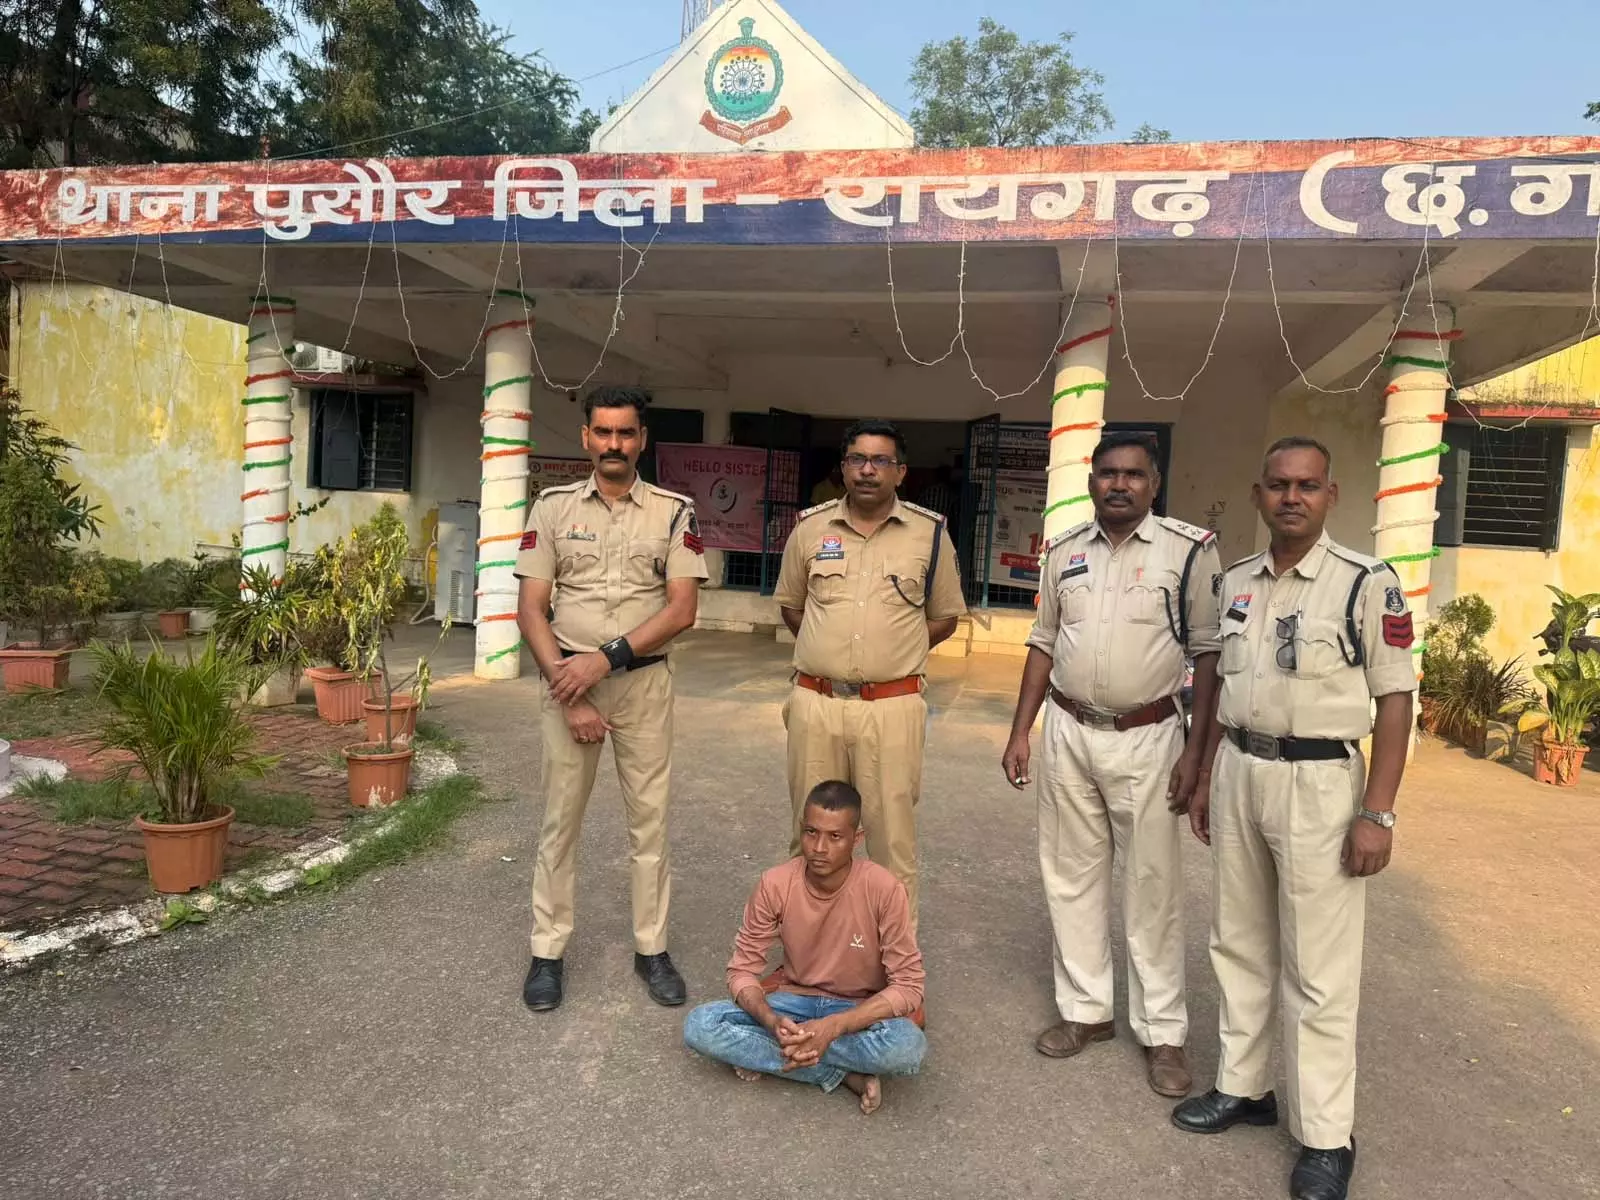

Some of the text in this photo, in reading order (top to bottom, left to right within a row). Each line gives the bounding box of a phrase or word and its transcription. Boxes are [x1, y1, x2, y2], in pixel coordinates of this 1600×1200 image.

[57, 178, 229, 225] थाना
[245, 158, 462, 240] पुसौर
[484, 158, 717, 227] जिला
[822, 171, 1230, 238] रायगढ़
[683, 459, 768, 477] HELLO SISTER
